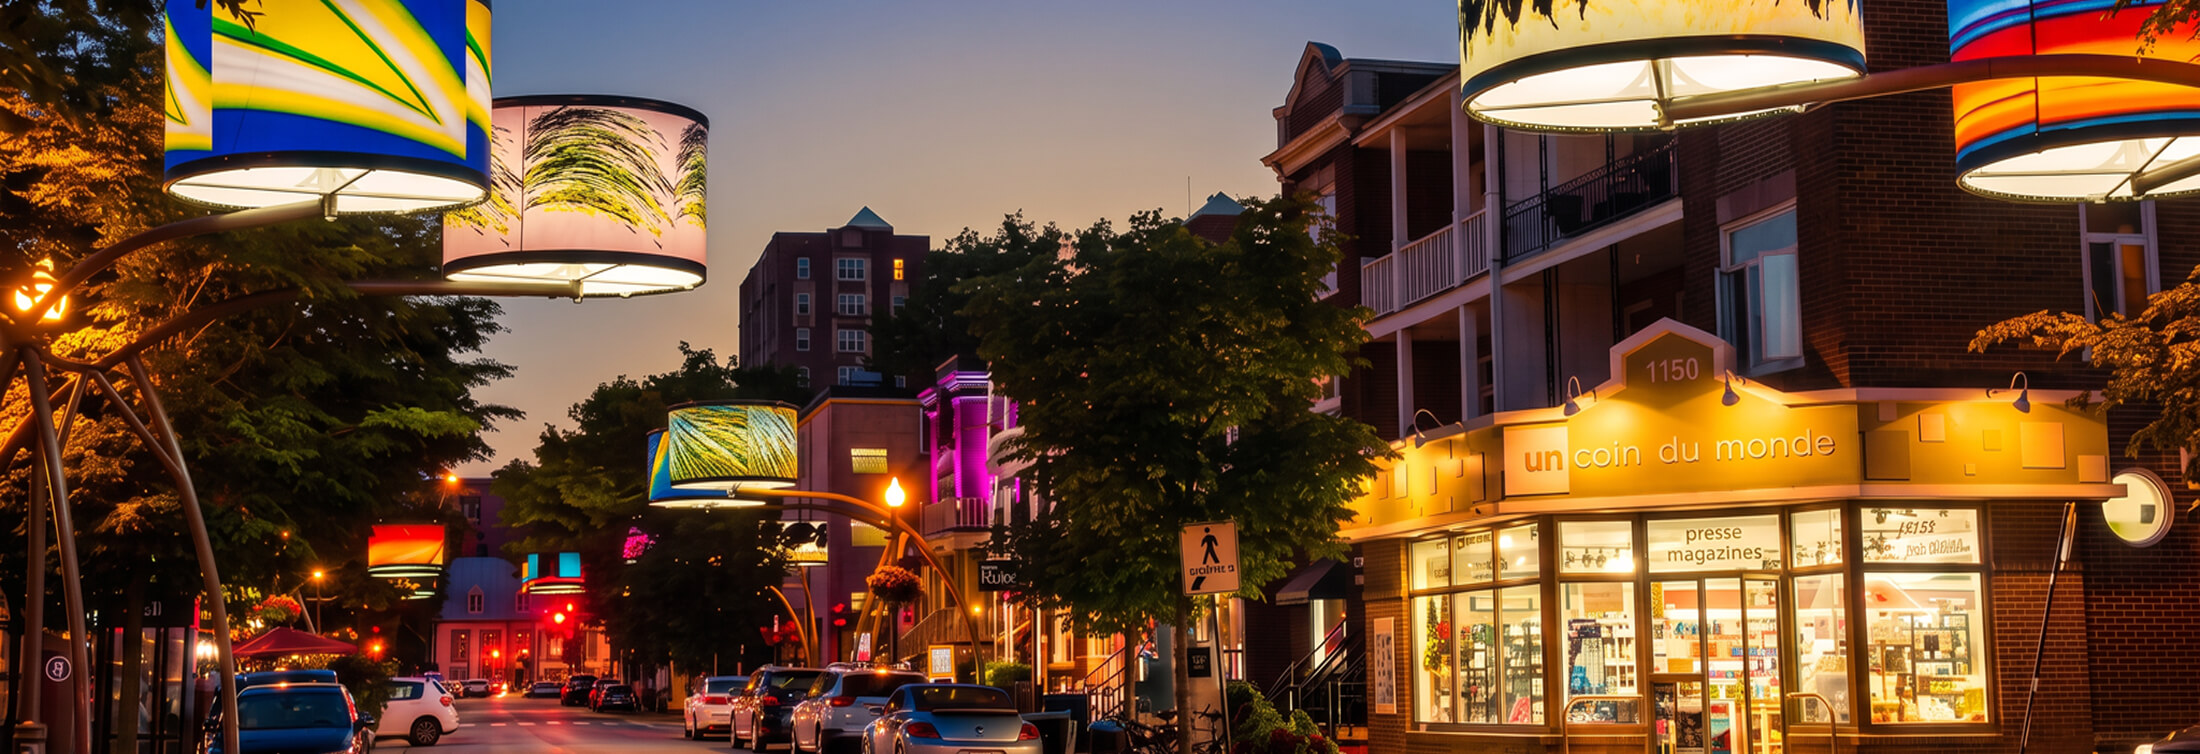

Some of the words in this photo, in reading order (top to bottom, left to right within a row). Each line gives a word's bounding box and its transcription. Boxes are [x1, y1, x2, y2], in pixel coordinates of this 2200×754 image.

[1646, 358, 1699, 384] 1150
[1524, 448, 1563, 472] un
[1574, 440, 1641, 468] coin
[1659, 435, 1700, 464] du
[1716, 428, 1836, 460] monde
[1686, 527, 1742, 545] presse
[1667, 546, 1762, 565] magazines
